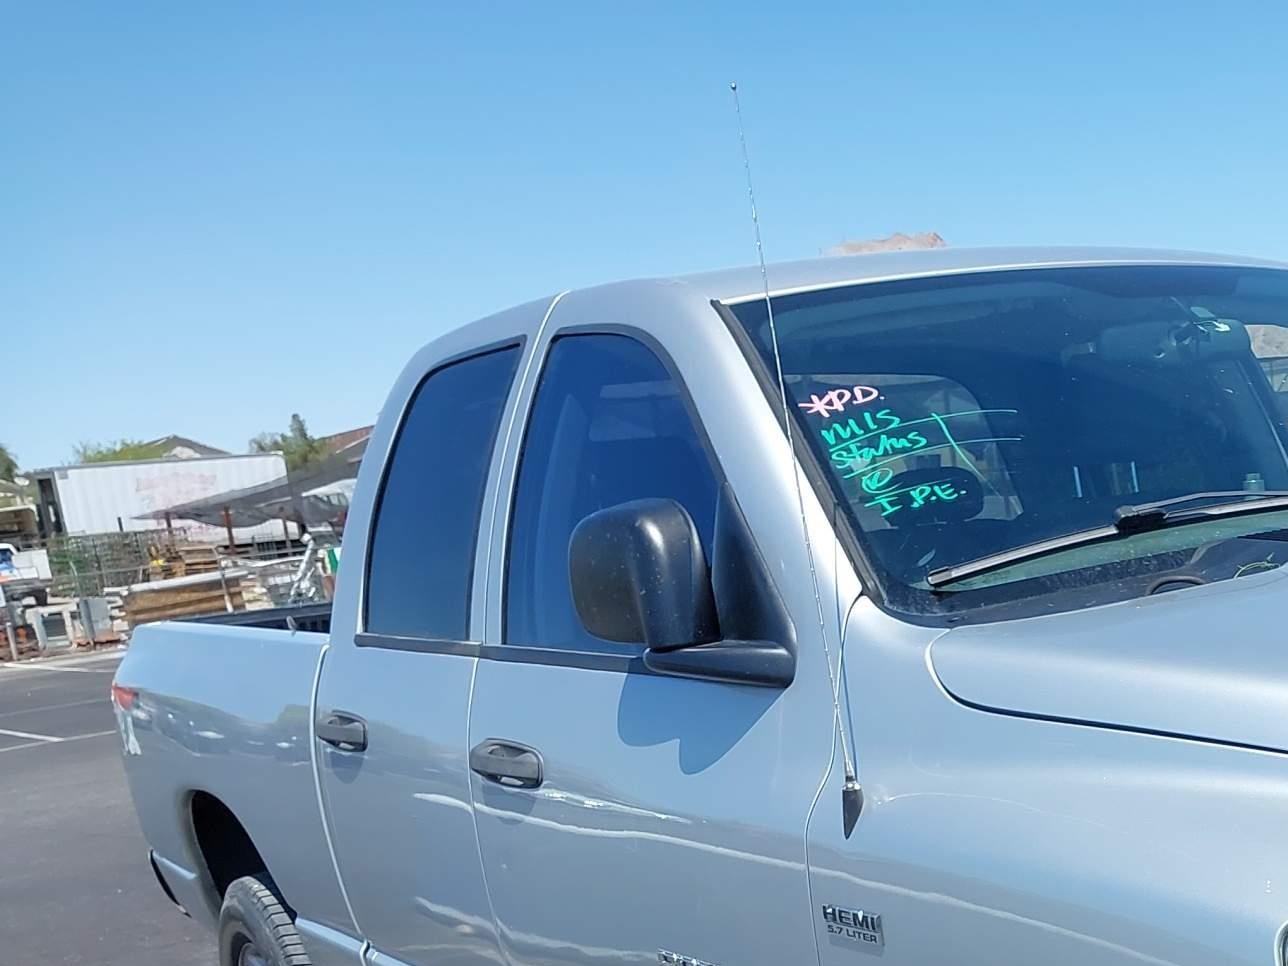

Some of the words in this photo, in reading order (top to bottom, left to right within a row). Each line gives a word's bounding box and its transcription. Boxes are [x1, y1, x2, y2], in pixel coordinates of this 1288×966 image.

[822, 904, 876, 930] HEMI
[827, 925, 843, 935] 5.7
[846, 928, 877, 943] LITER
